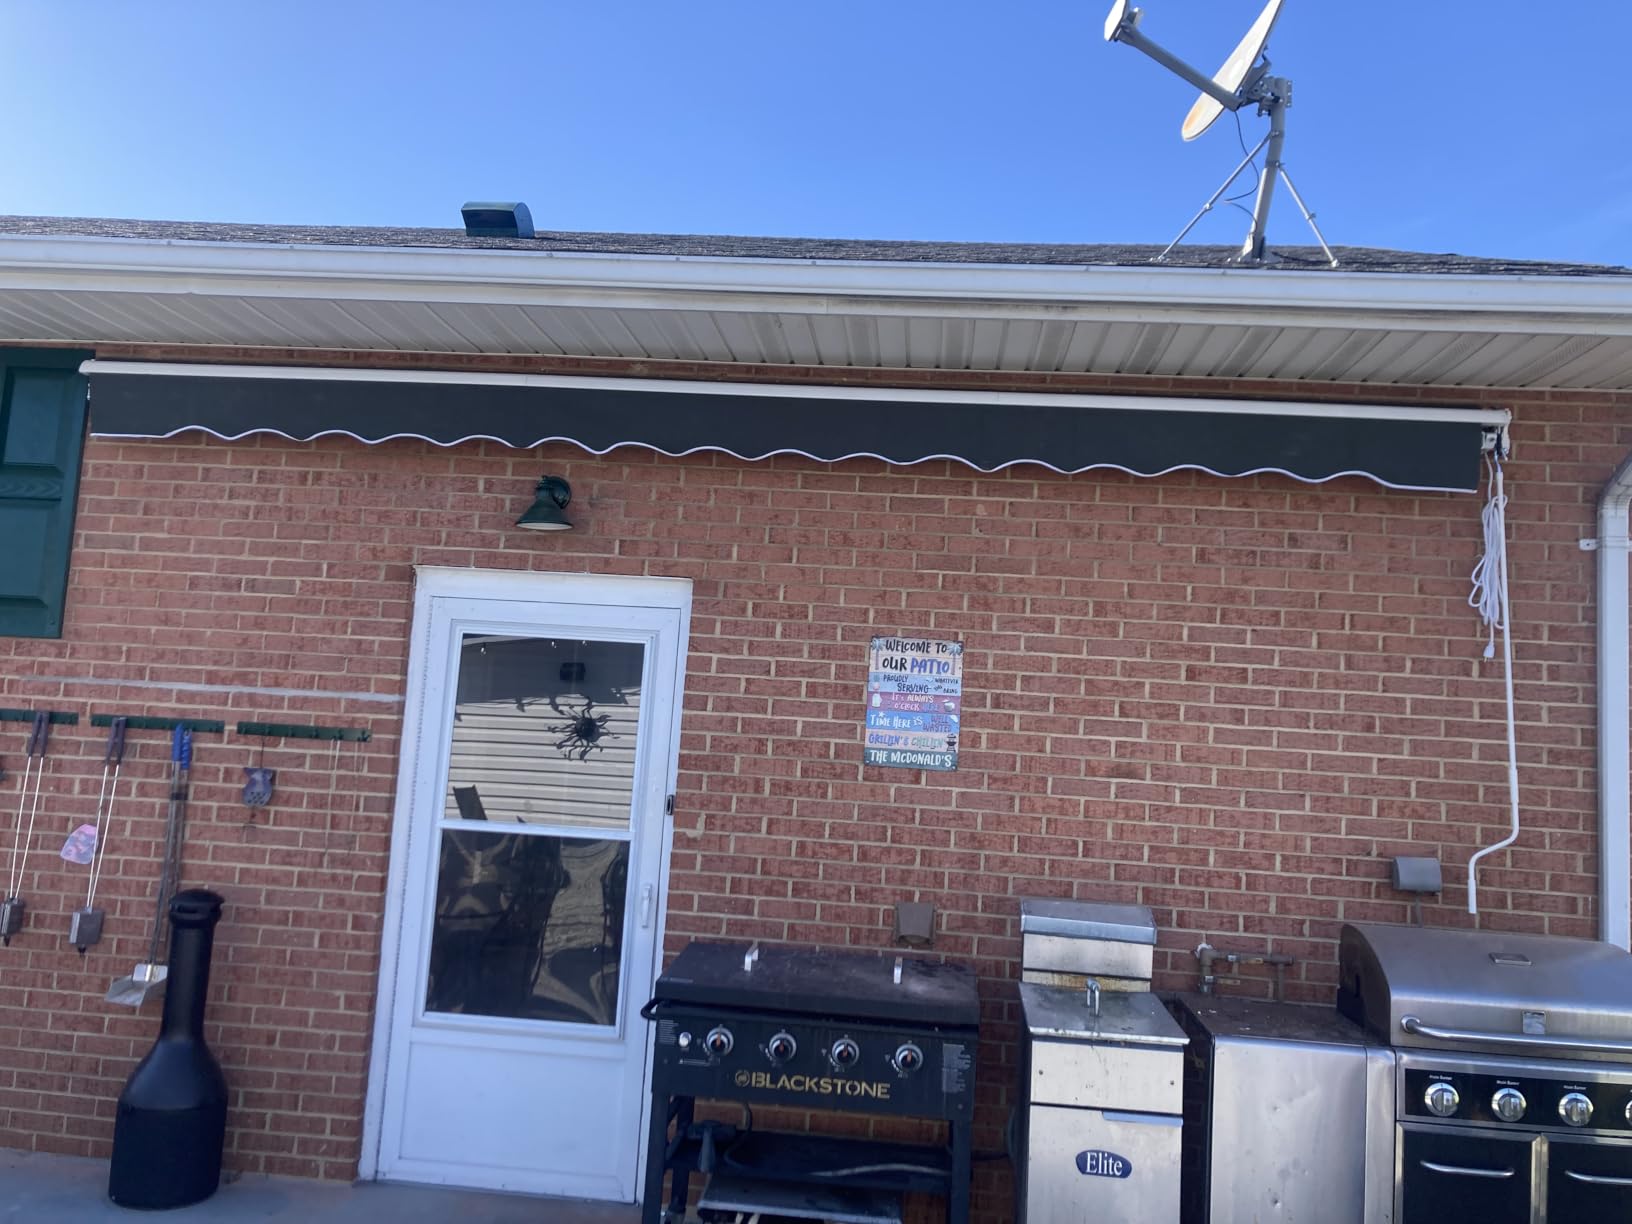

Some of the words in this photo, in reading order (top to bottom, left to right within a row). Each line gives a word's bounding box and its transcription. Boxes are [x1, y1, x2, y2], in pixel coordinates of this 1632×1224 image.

[885, 639, 931, 654] WELCOME
[935, 642, 948, 654] TO
[882, 656, 907, 671] OUR
[910, 657, 950, 674] PATIO
[883, 674, 909, 683] PROUDLY
[897, 682, 930, 693] SERVING
[907, 694, 934, 703] ALWAYS
[870, 714, 891, 727] TIME
[893, 715, 911, 729] HERE
[869, 750, 889, 764] THE
[752, 1072, 891, 1099] BLACKSTONE
[1086, 1152, 1123, 1176] Elite
